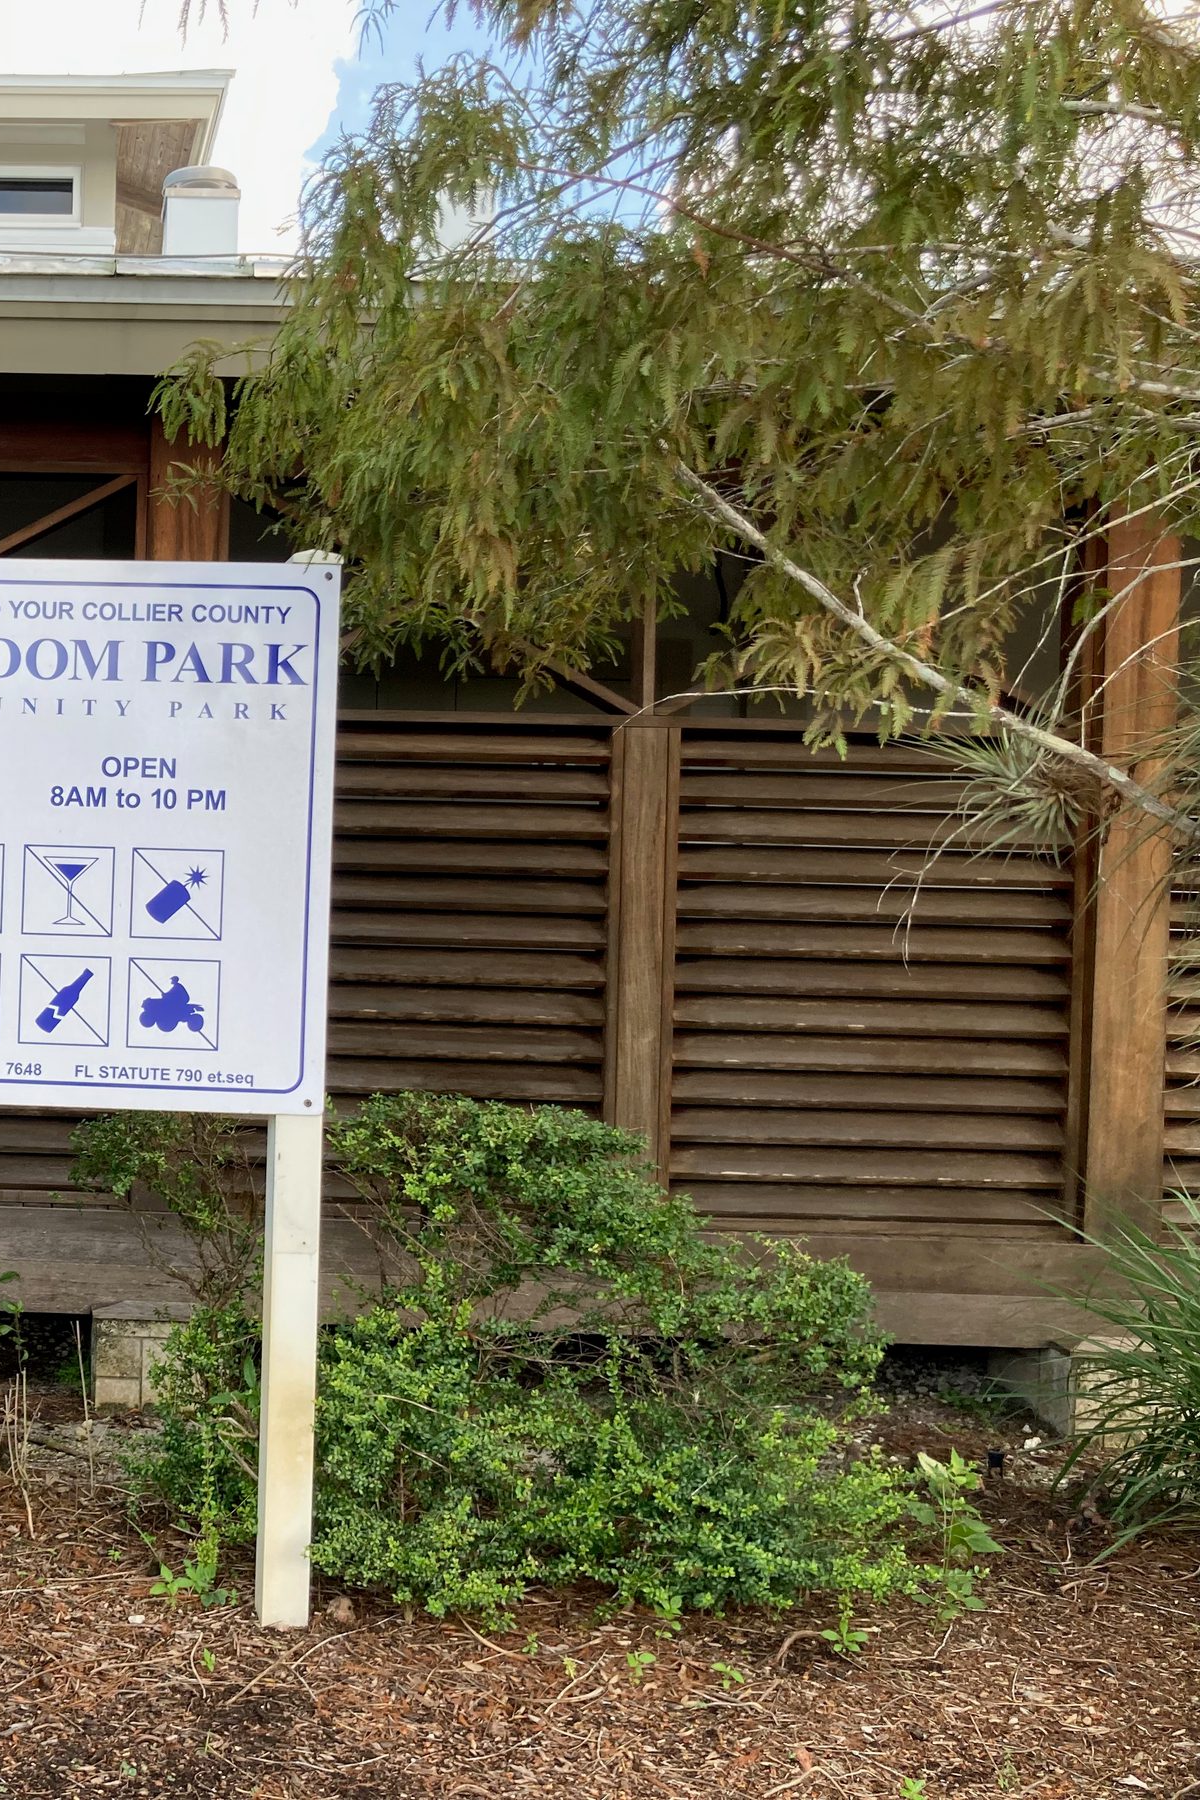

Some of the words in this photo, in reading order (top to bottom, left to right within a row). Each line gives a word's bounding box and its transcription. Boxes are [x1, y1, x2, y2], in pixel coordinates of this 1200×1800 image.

[8, 600, 74, 621] YOUR
[82, 601, 184, 623] COLLIER
[191, 603, 293, 625] COUNTY
[140, 640, 310, 686] PARK
[169, 701, 288, 721] PARK
[101, 755, 177, 779] OPEN
[50, 785, 107, 808] 8AM
[115, 787, 141, 809] to
[150, 787, 178, 810] 10
[186, 789, 227, 811] PM
[74, 1064, 94, 1078] FL
[98, 1065, 171, 1081] STATUTE
[175, 1068, 203, 1083] 790
[207, 1070, 254, 1088] et.seq
